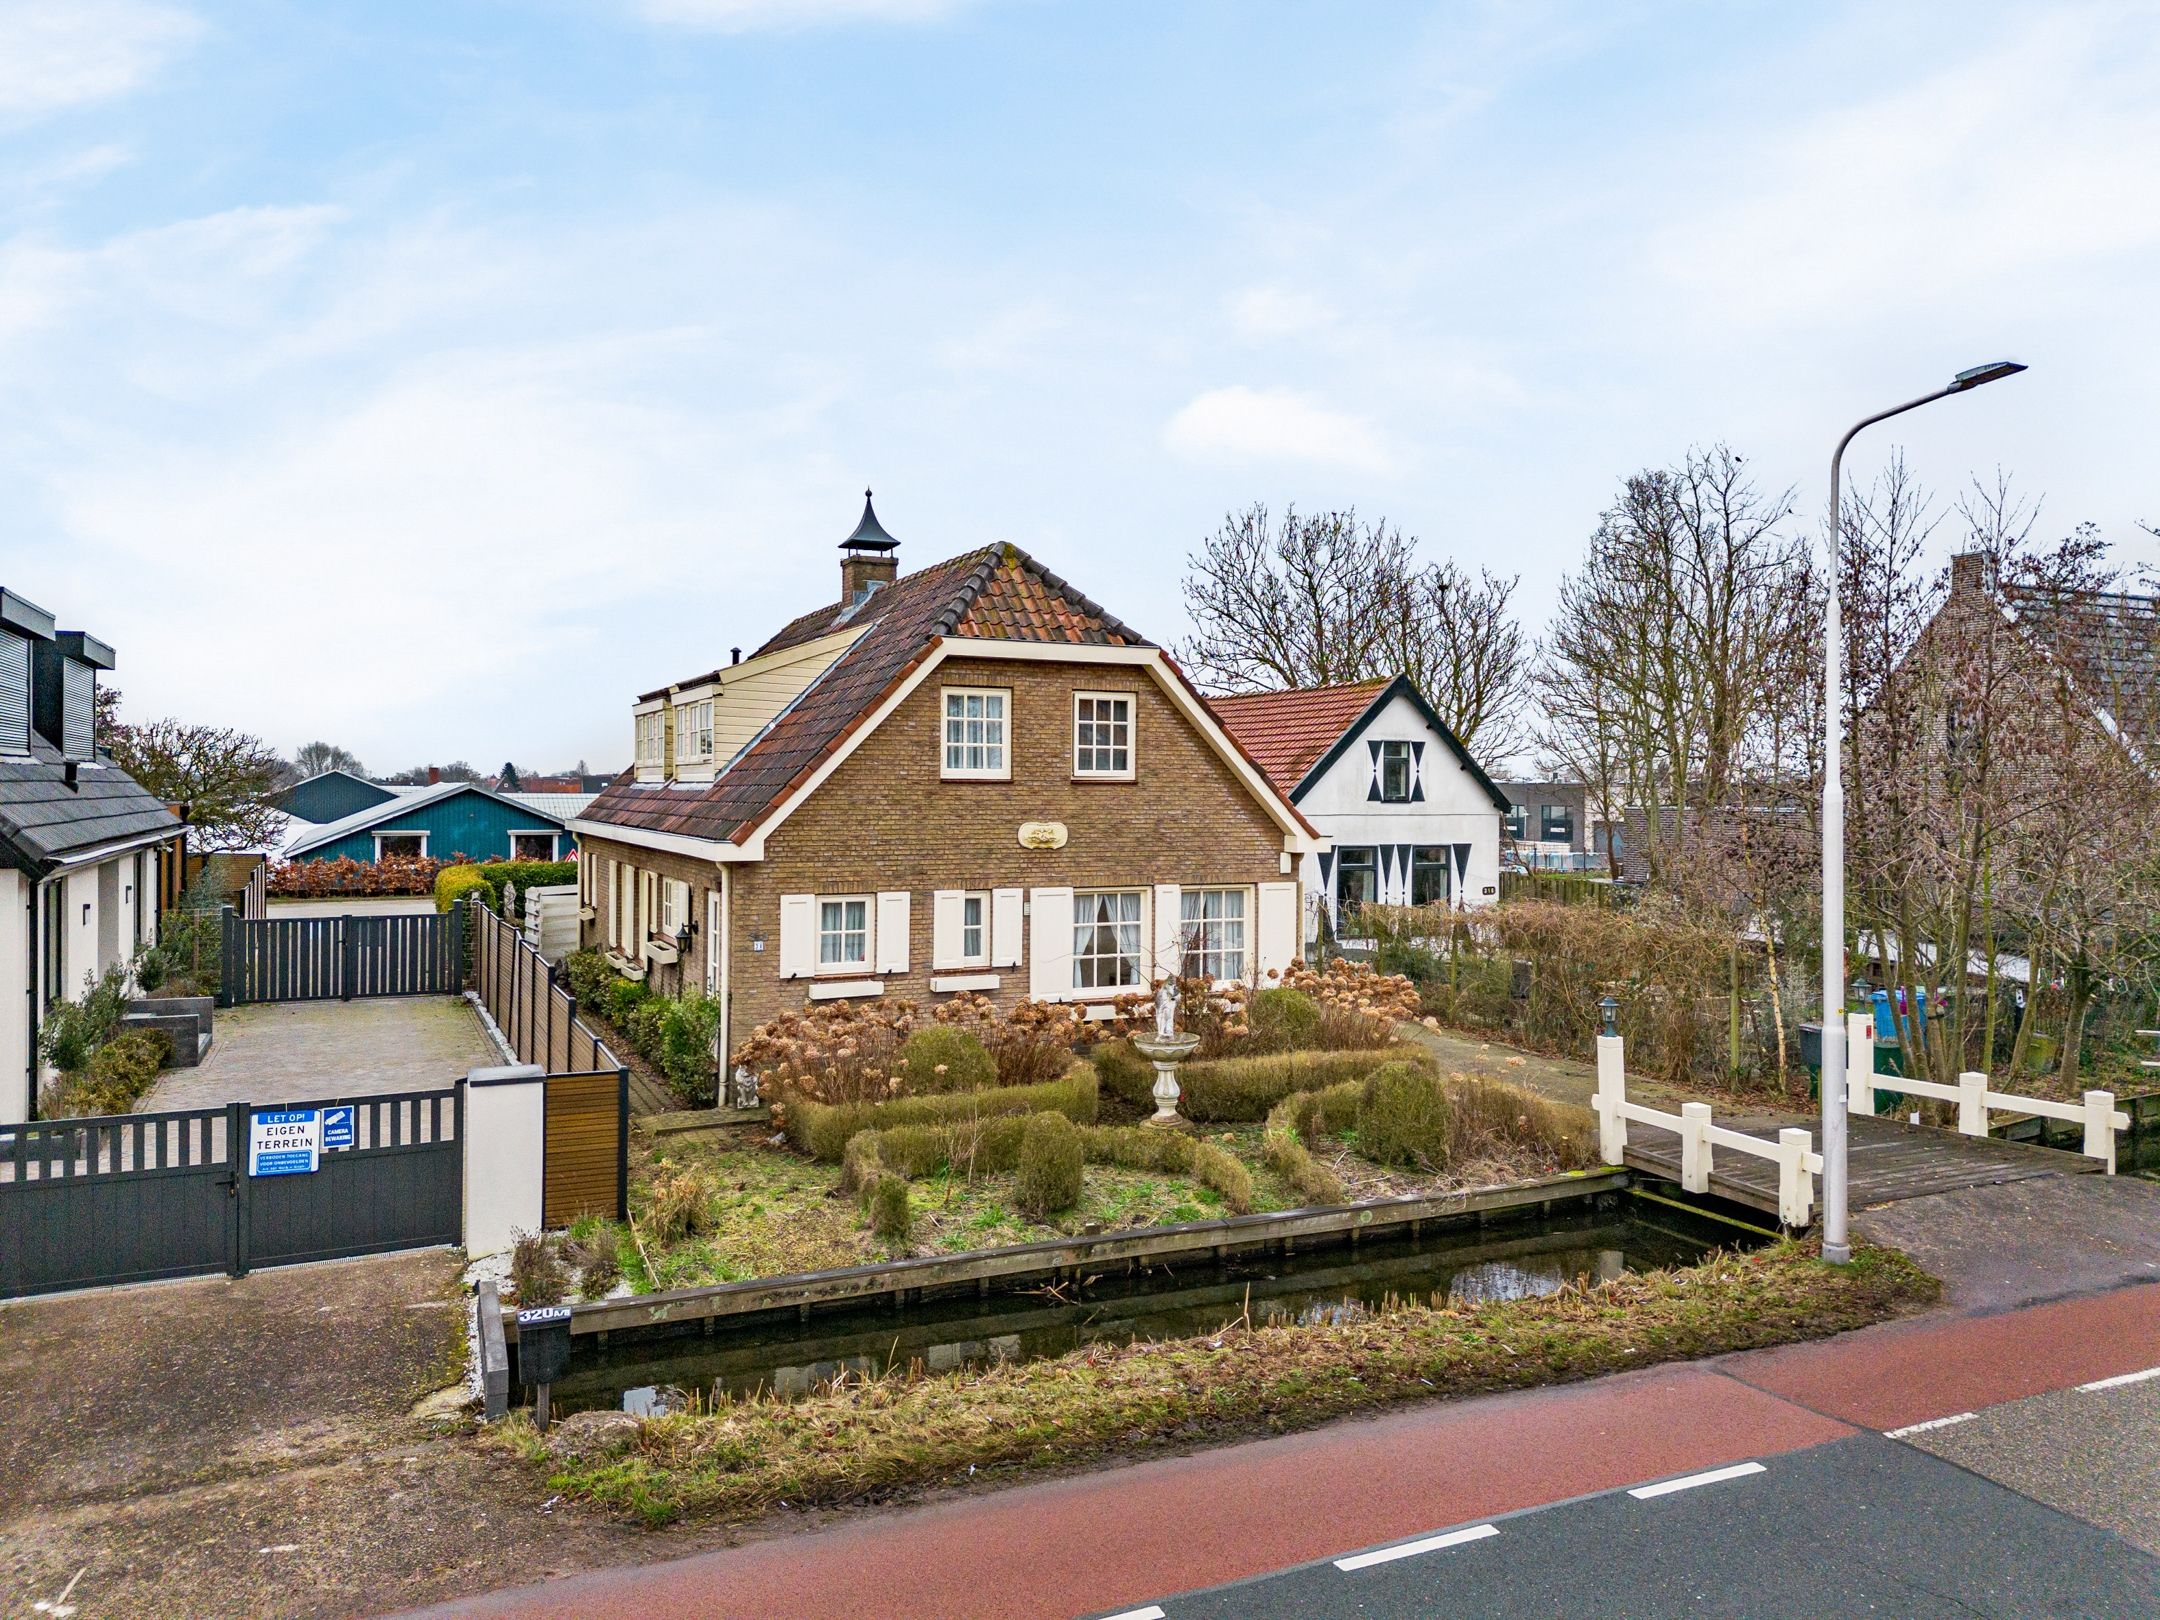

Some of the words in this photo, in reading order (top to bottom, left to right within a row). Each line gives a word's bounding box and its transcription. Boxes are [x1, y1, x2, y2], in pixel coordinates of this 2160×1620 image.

[267, 1114, 286, 1123] LET
[289, 1113, 305, 1122] OP!
[267, 1125, 305, 1136] EIGEN
[257, 1138, 313, 1150] TERREIN
